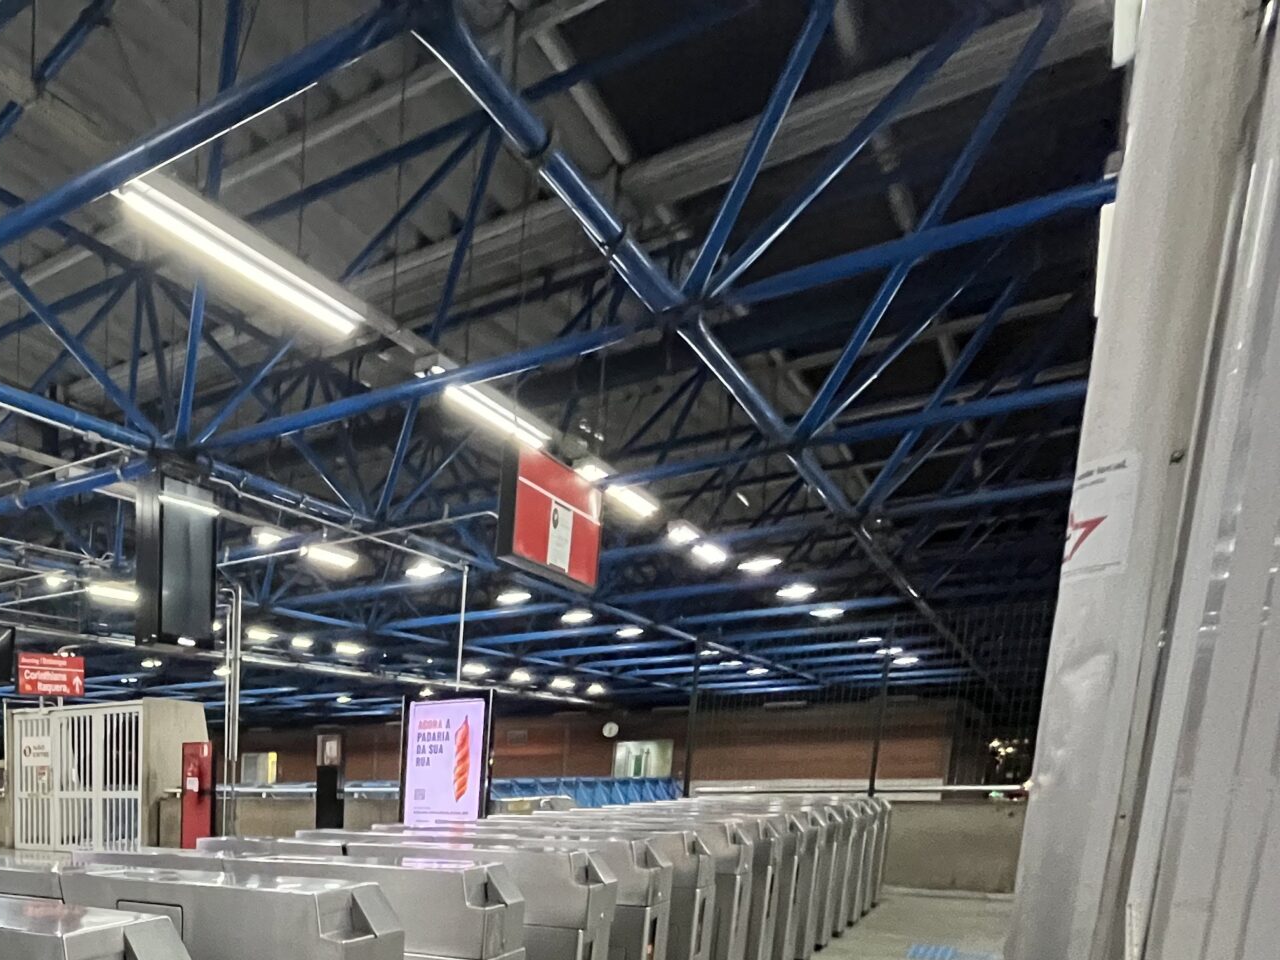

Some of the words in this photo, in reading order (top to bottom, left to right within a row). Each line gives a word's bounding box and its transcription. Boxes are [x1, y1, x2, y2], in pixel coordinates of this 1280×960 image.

[418, 719, 443, 730] AGORA
[417, 731, 449, 742] PADARIA
[416, 744, 426, 755] DA
[428, 744, 444, 755] SUA
[416, 757, 430, 767] RUA
